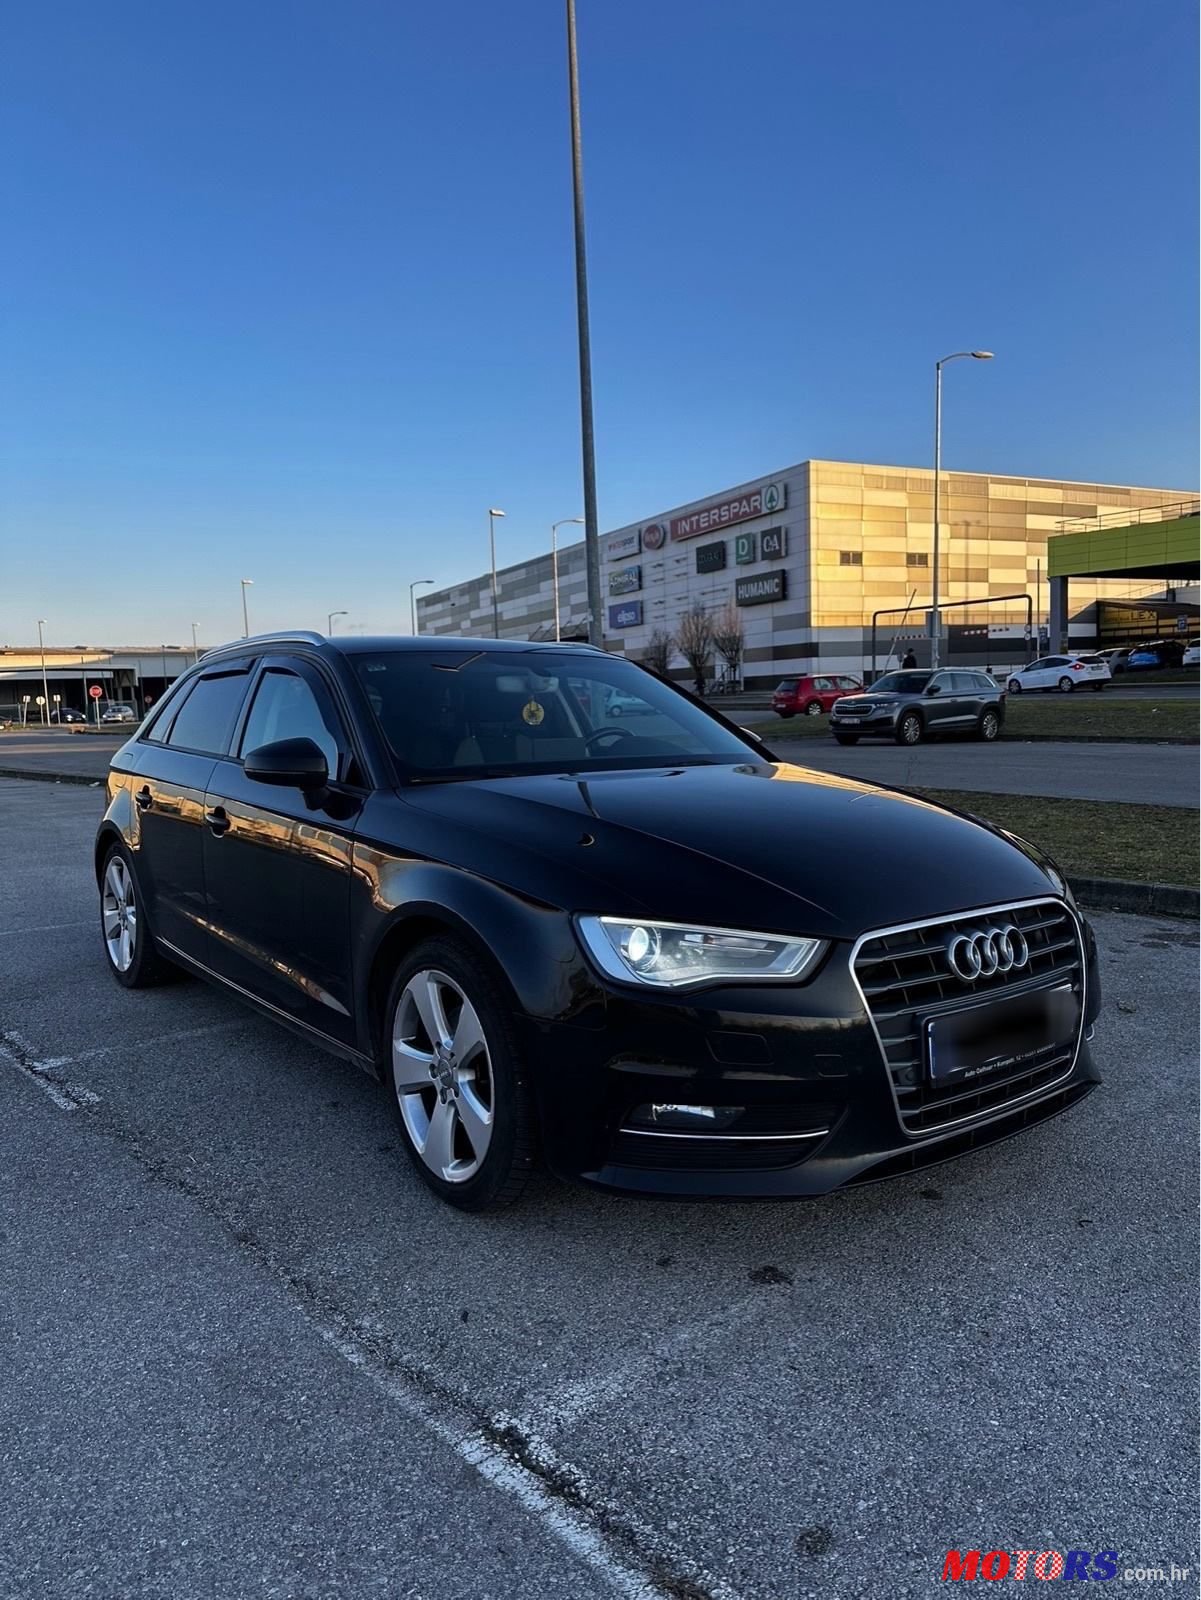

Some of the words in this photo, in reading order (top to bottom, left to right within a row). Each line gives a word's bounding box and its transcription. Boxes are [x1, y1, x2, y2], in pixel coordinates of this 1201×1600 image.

[677, 495, 761, 535] INTERSPAR
[739, 538, 748, 555] D
[738, 578, 780, 599] HUMANIC
